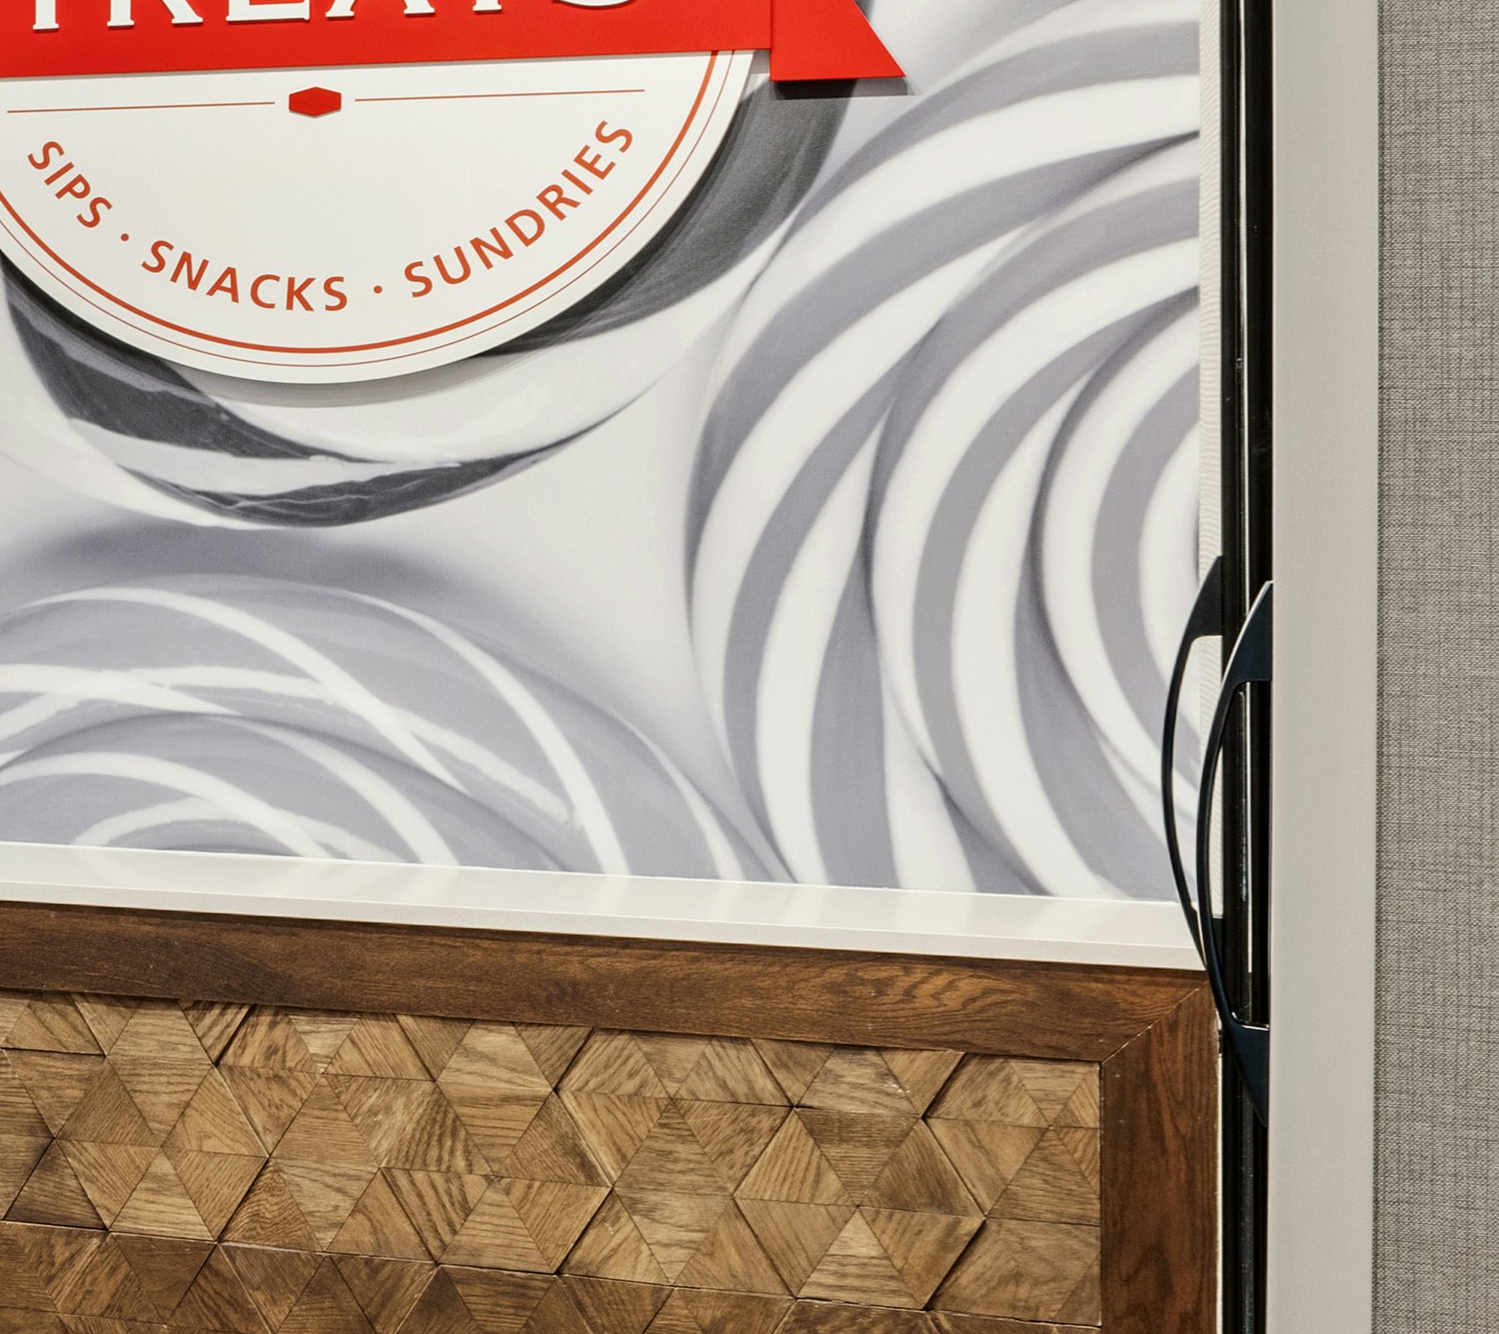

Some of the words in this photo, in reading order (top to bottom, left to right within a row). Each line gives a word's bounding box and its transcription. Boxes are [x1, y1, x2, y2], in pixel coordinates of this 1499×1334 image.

[27, 139, 113, 231] SIPS
[140, 238, 349, 313] SNACKS
[402, 118, 635, 299] SUNDRIES
